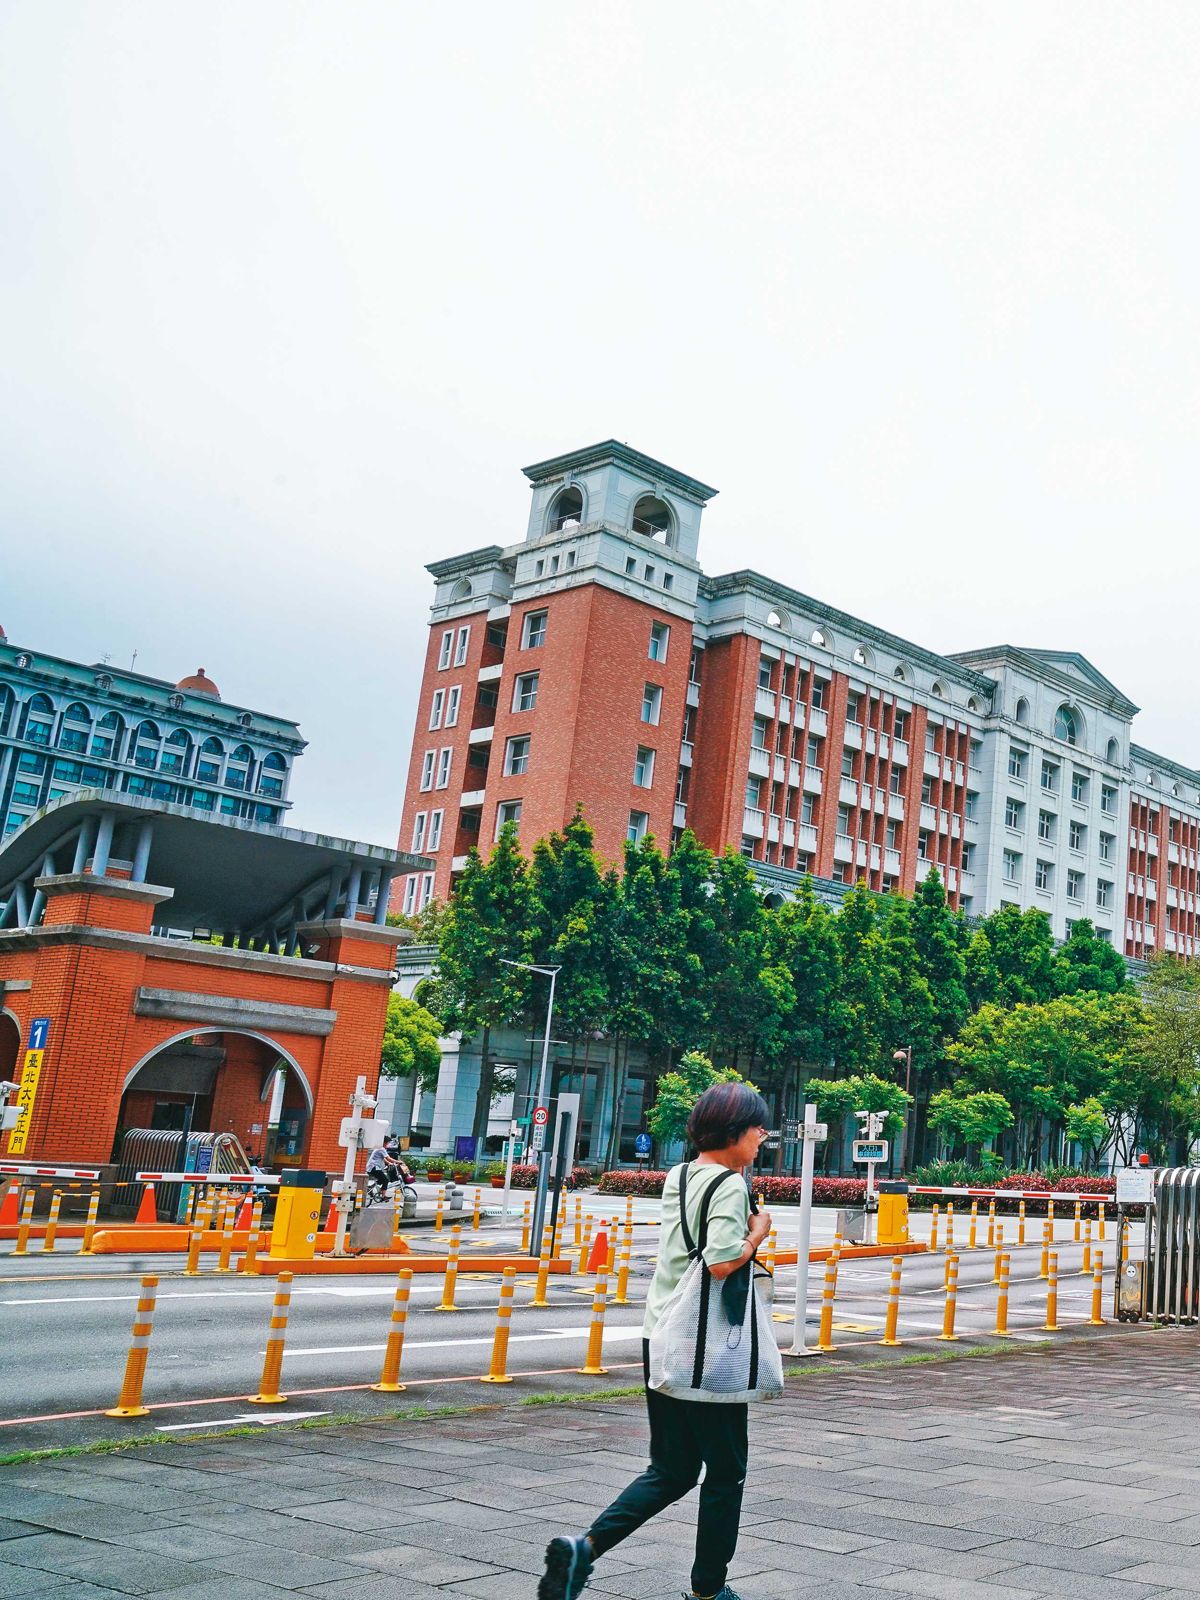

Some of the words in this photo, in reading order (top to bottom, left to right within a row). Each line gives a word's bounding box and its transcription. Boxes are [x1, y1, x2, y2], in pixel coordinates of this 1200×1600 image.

[33, 1026, 43, 1048] 1
[11, 1053, 38, 1151] 臺北大學正門
